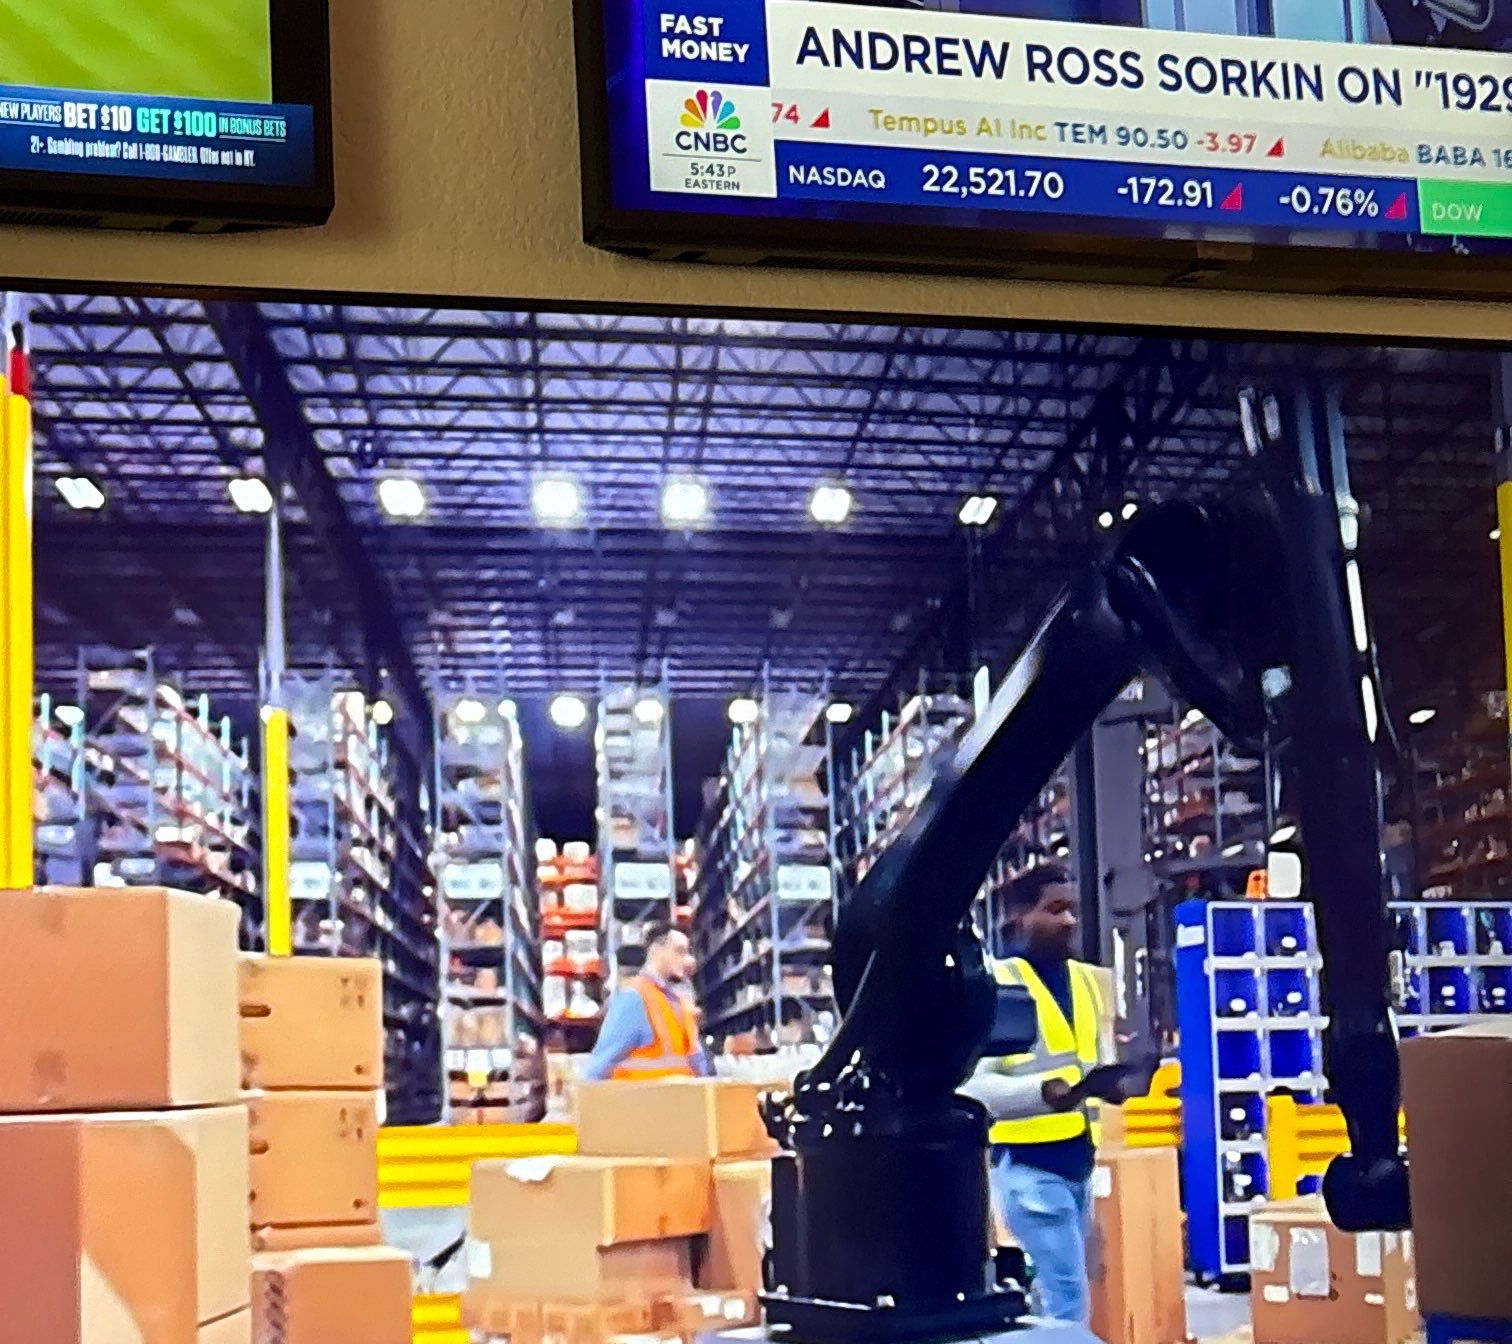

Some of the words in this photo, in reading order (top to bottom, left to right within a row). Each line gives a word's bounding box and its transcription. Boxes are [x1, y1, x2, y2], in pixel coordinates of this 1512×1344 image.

[659, 13, 724, 38] FAST
[661, 37, 750, 64] MONEY
[795, 26, 1011, 80] ANDREW
[1026, 43, 1144, 90] ROSS
[1157, 53, 1325, 103] SORKIN
[1337, 66, 1403, 107] ON
[20, 102, 63, 123] PLAYERS
[63, 101, 99, 130] BET
[100, 103, 133, 132] $10
[136, 107, 172, 135] GET
[173, 109, 217, 138] $100
[229, 116, 263, 136] BONUS
[263, 119, 287, 138] BETS
[868, 108, 967, 137] Tempus
[976, 116, 1002, 138] AI
[1009, 119, 1048, 142] Inc
[1054, 121, 1107, 146] TEM
[1116, 125, 1189, 152] 90.50
[1196, 129, 1259, 156] -3.97
[675, 129, 748, 155] CNBC
[1320, 136, 1411, 164] Alibaba
[1415, 143, 1487, 168] BABA
[684, 177, 741, 192] EASTERN
[788, 164, 887, 191] NASDAQ
[921, 163, 1065, 201] 22,521.70
[1117, 175, 1213, 209] -172.91
[1279, 184, 1380, 219] -0.76%
[1431, 201, 1484, 223] DOW
